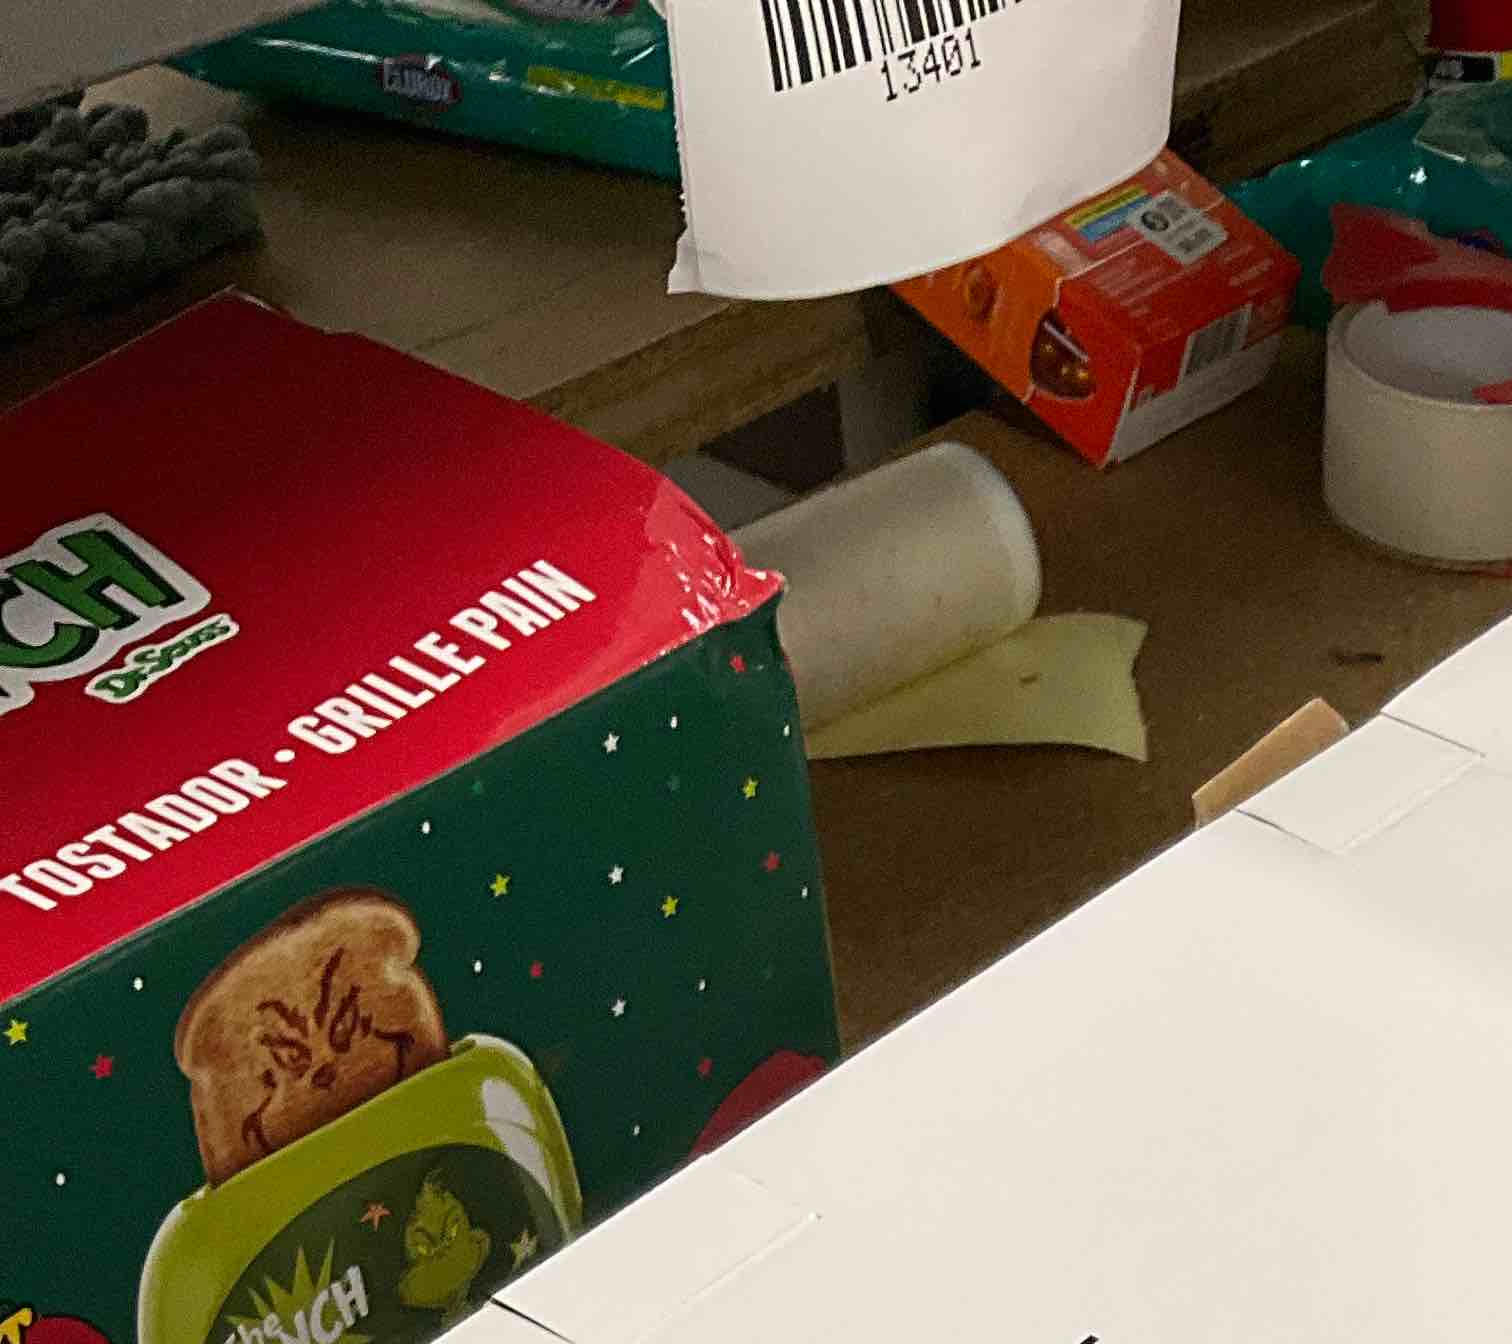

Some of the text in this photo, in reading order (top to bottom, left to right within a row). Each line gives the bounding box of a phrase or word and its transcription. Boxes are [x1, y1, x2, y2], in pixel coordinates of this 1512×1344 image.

[881, 27, 981, 102] 13401
[0, 559, 597, 911] TOSTADOR GRILLE PAIN
